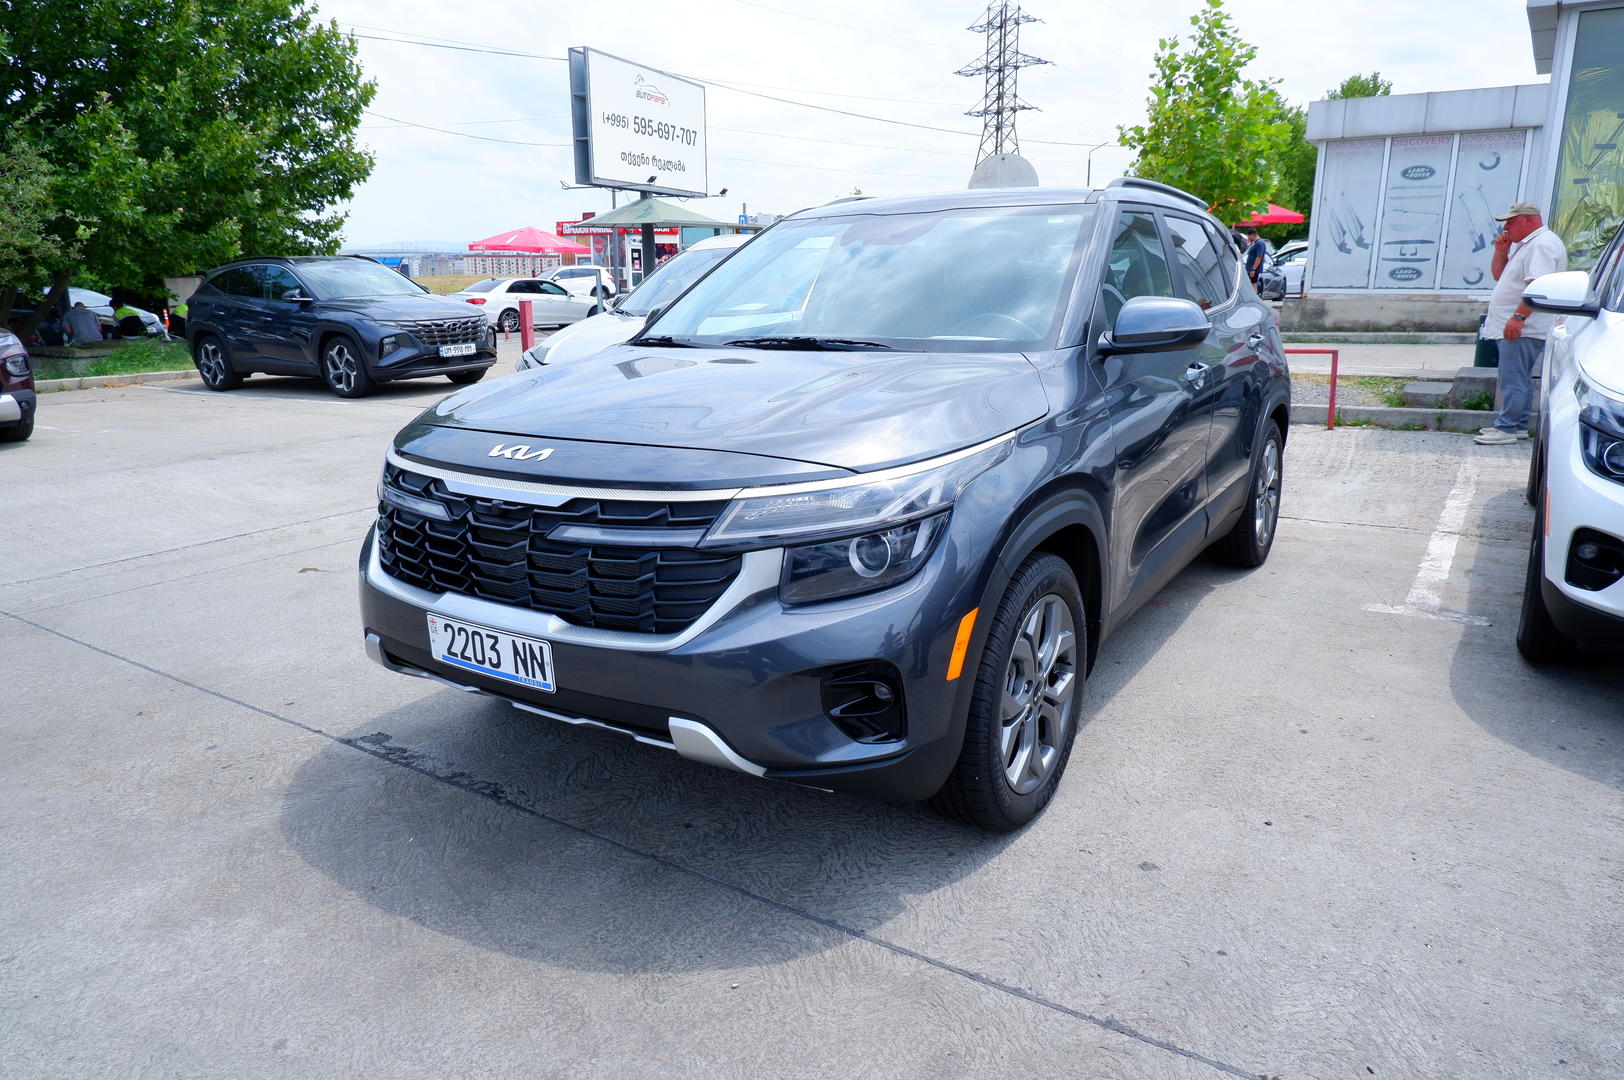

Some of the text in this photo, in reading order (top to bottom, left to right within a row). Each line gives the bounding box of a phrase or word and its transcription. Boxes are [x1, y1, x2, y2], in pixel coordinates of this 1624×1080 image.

[602, 111, 697, 147] (+995) 595-697-707
[1391, 136, 1452, 146] DISCOVERY
[620, 150, 686, 173] თქვენი რეკლამა
[488, 443, 554, 462] KIA
[430, 625, 438, 635] GE
[443, 622, 547, 682] 2203 NN
[518, 677, 545, 688] TRANSIT
